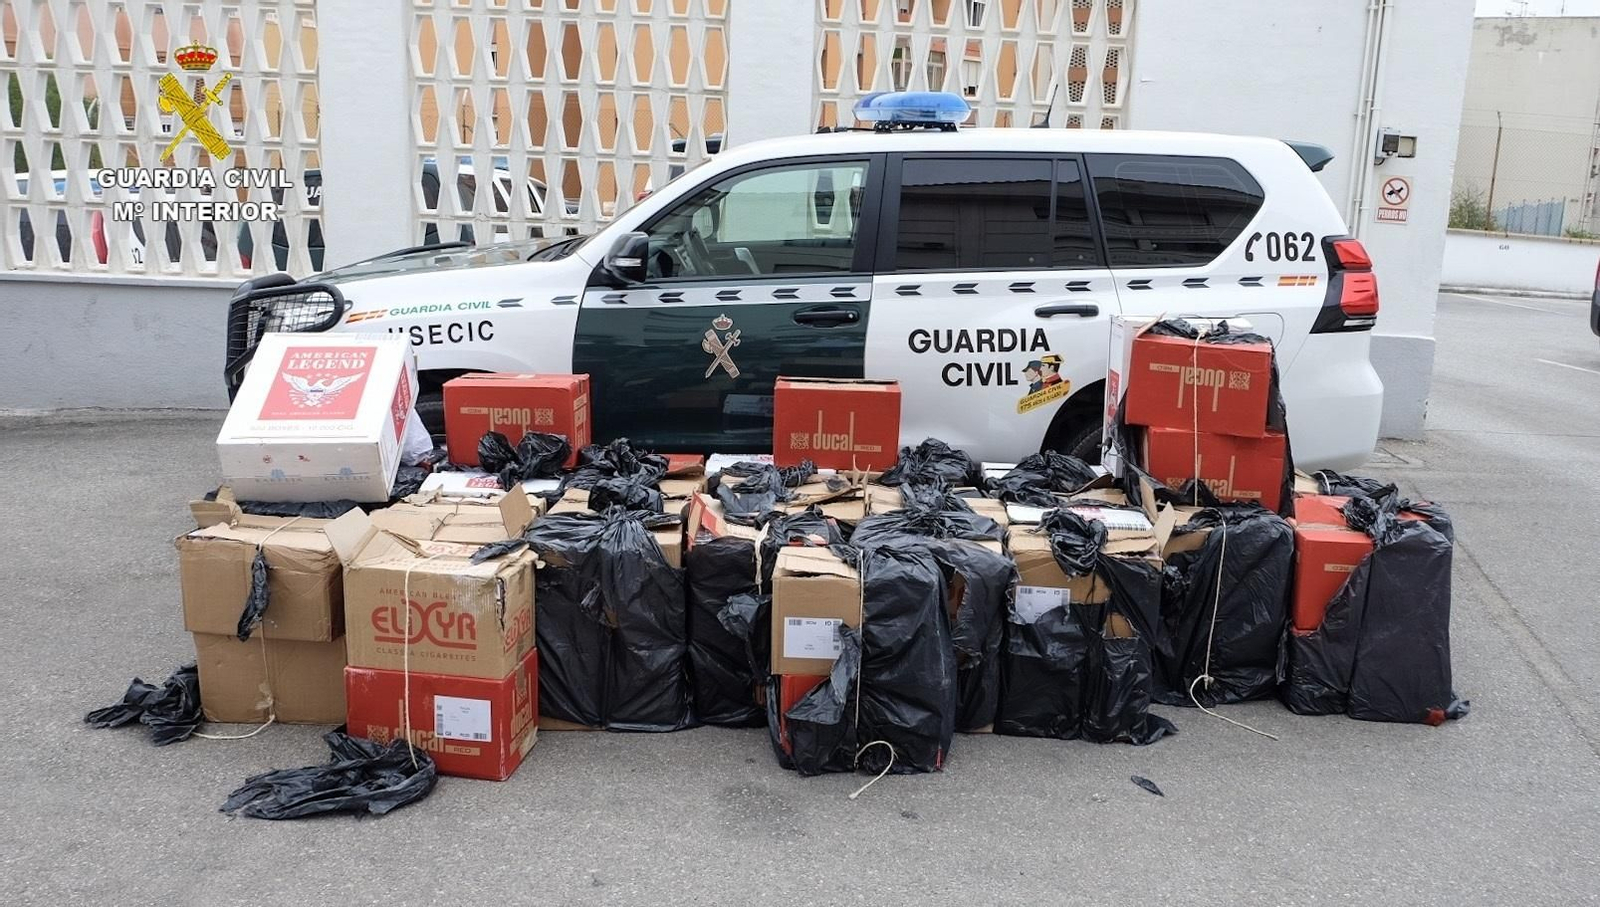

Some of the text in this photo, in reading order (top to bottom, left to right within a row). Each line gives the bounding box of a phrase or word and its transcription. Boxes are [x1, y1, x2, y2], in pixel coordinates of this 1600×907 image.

[1378, 209, 1399, 219] PERROS
[1266, 231, 1316, 262] 062
[389, 301, 492, 317] GUARDIA CIVIL
[388, 319, 494, 347] SECIC
[908, 328, 1051, 354] GUARDIA
[287, 359, 366, 370] LEGEND
[941, 362, 1019, 387] CIVIL
[1177, 366, 1226, 412] ducal
[489, 407, 531, 438] ducal
[813, 410, 855, 451] ducal
[420, 652, 478, 663] CIGARETTES
